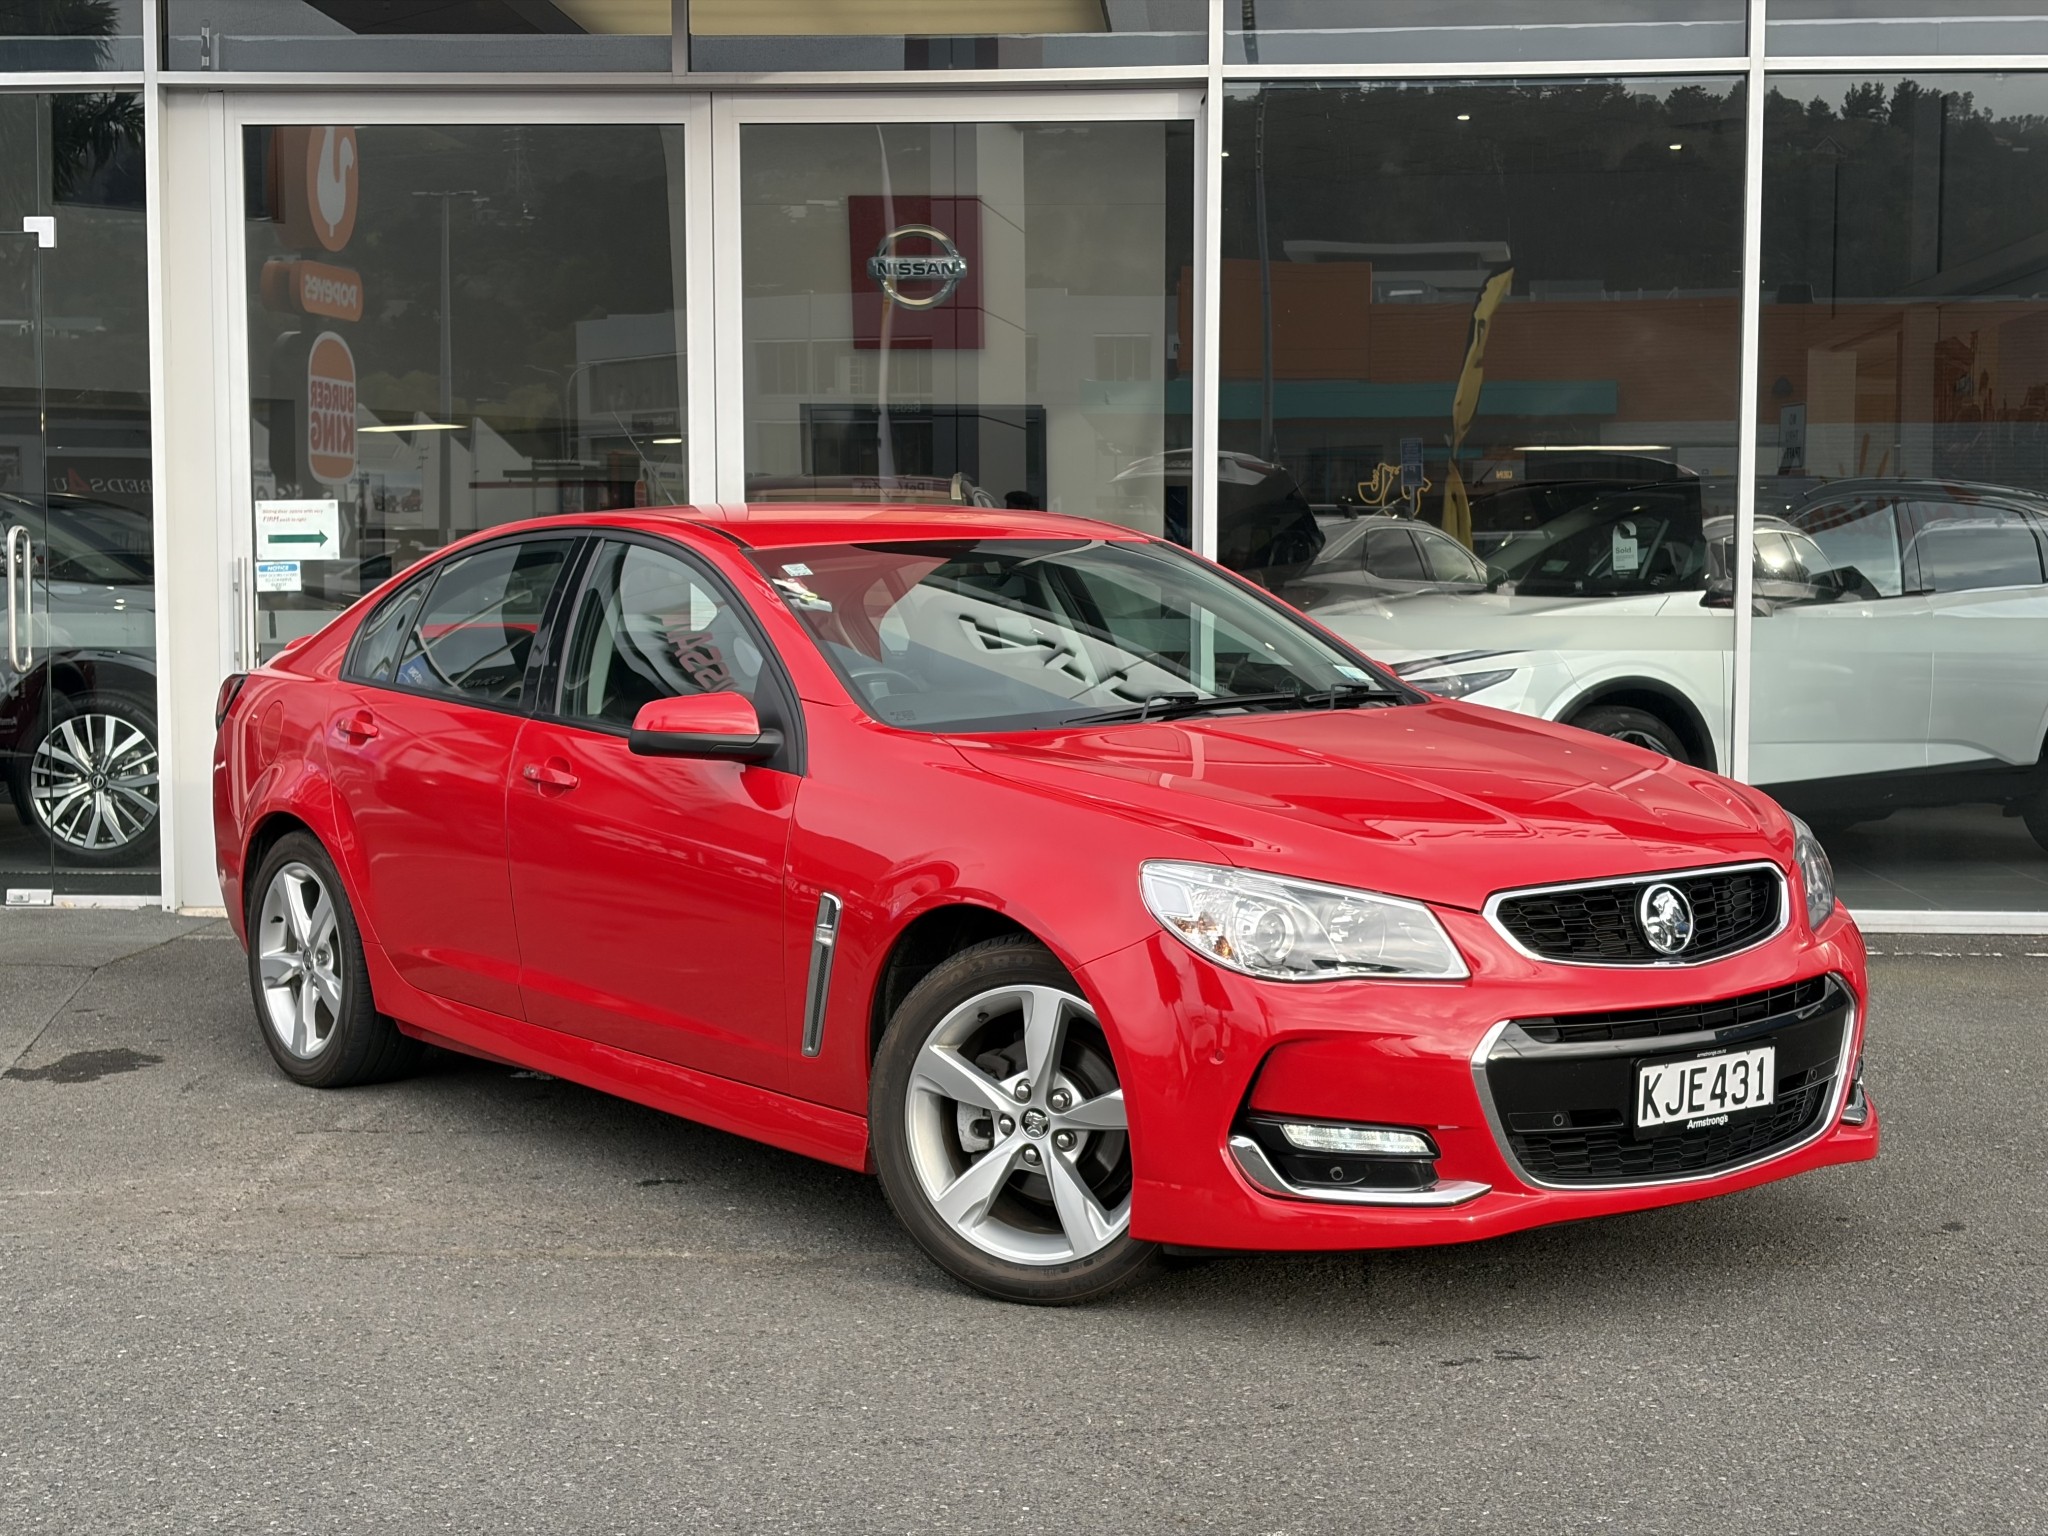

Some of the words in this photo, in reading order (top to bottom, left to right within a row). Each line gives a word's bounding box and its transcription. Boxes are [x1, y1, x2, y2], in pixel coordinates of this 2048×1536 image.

[876, 261, 957, 276] NISSAN
[262, 515, 280, 523] FIRM
[1615, 546, 1632, 555] Sold
[1641, 1056, 1765, 1121] KJE431
[1686, 1114, 1729, 1130] Armstrong's
